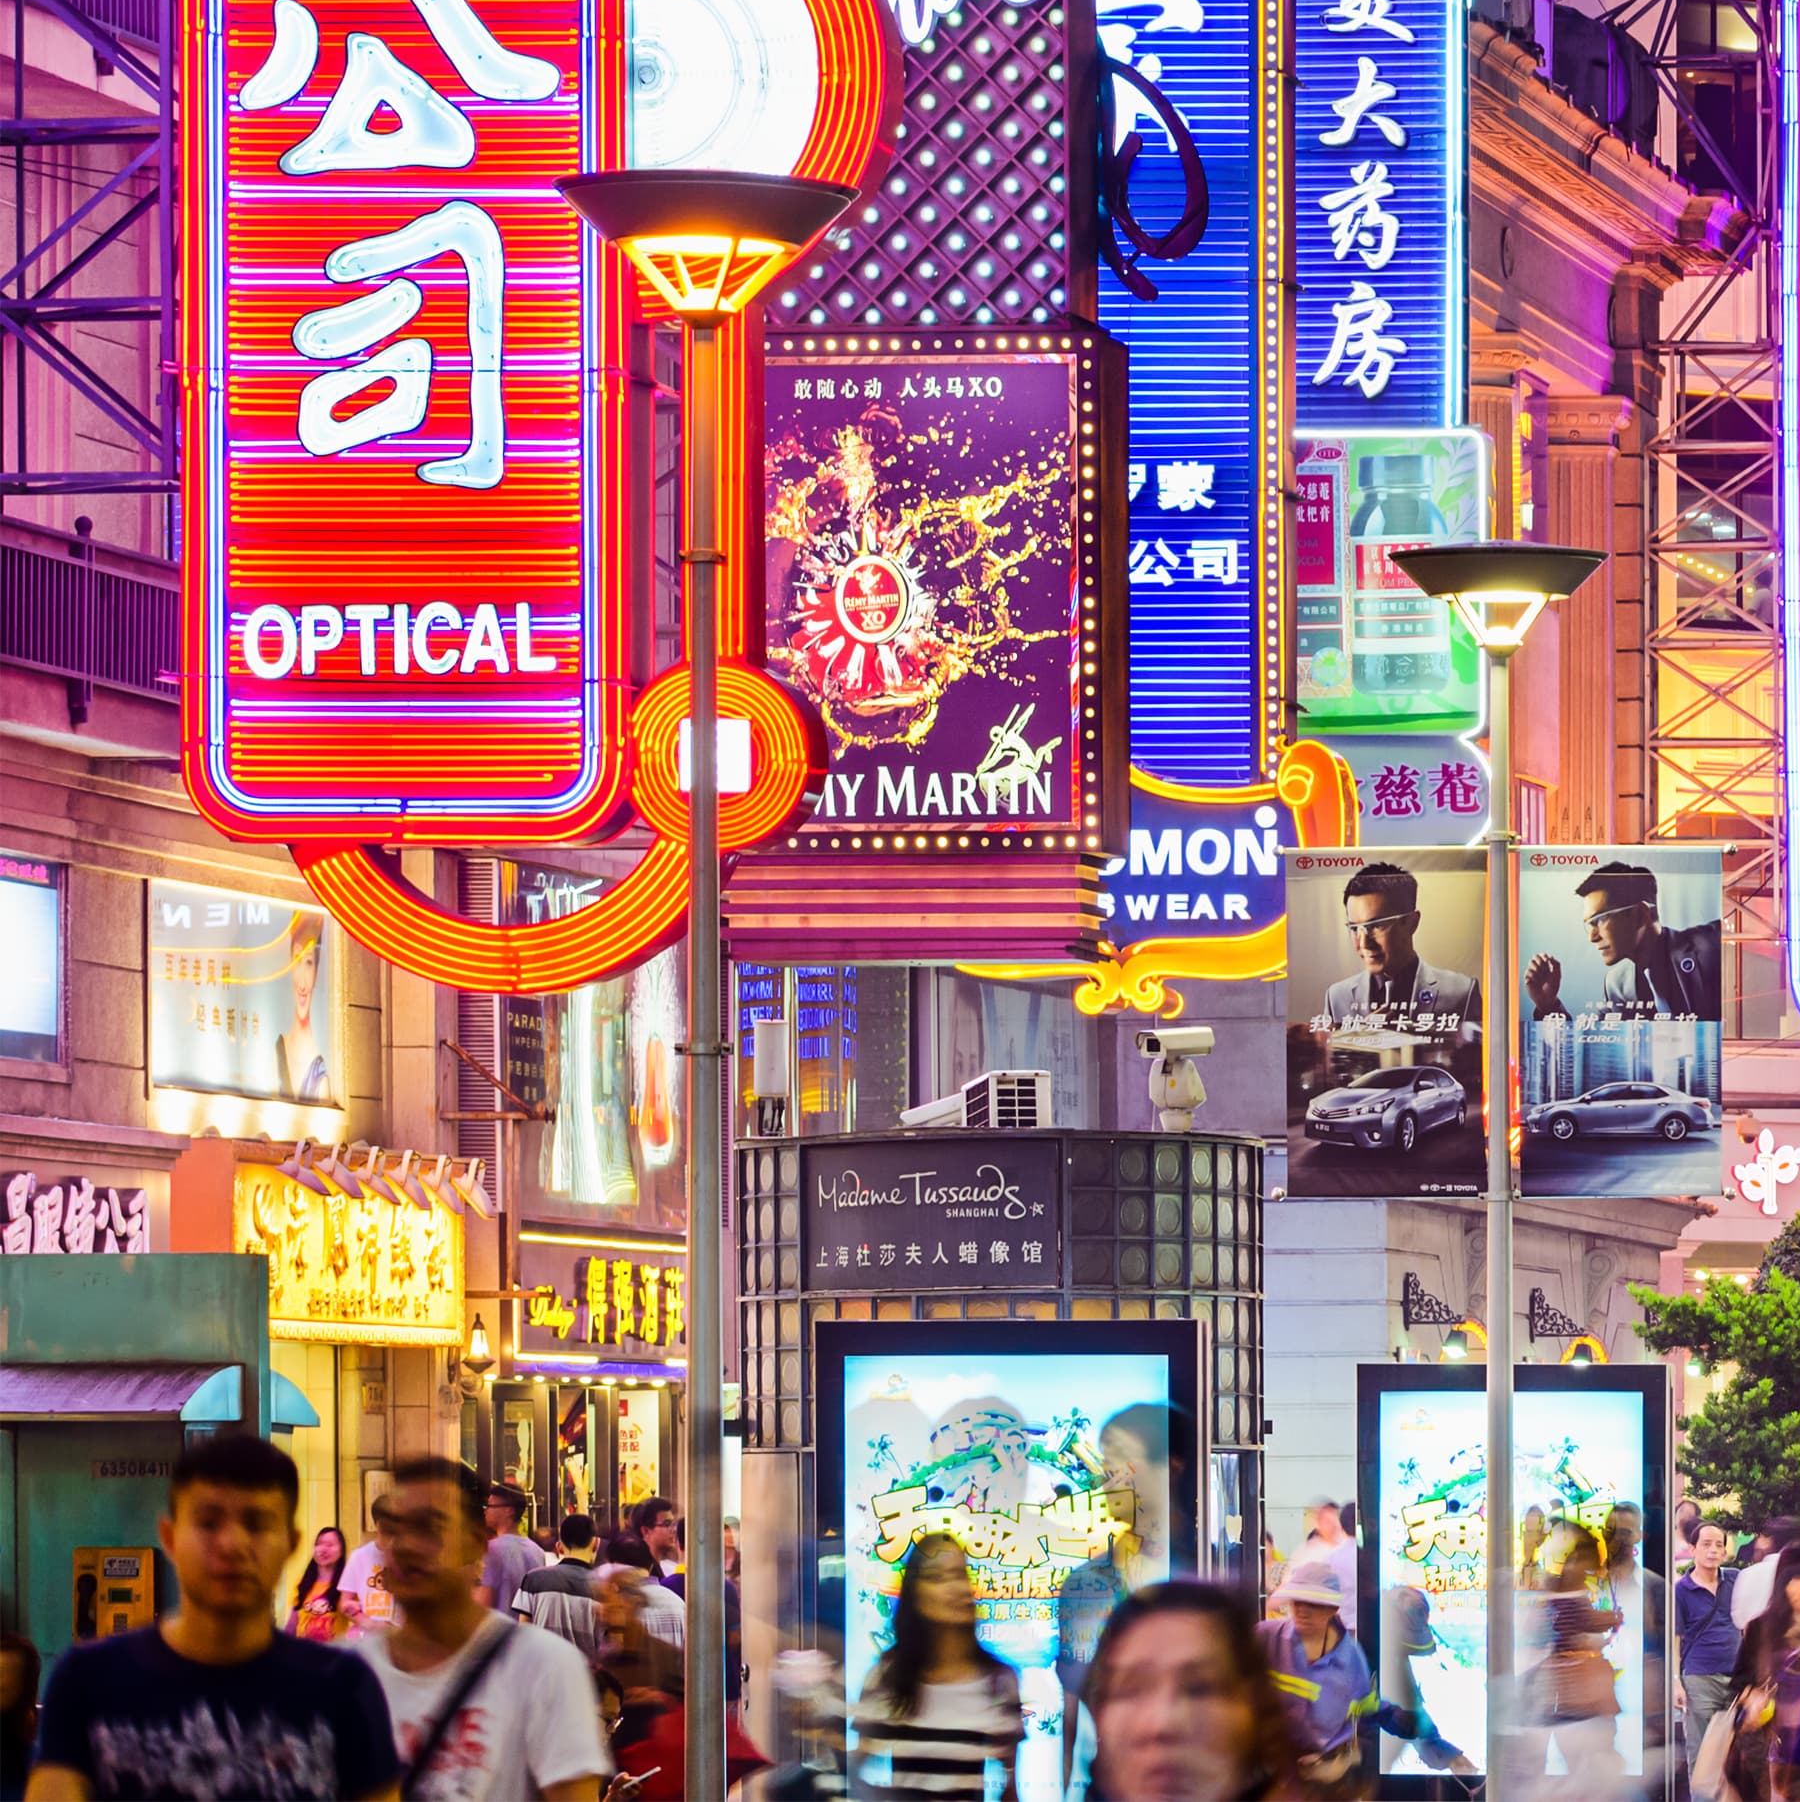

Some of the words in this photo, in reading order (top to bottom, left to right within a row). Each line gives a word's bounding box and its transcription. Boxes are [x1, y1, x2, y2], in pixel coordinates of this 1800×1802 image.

[794, 377, 882, 400] 敢随心动
[861, 611, 886, 626] XO
[242, 601, 557, 679] OPTICAL
[876, 765, 1052, 818] MARTIN
[1316, 855, 1365, 868] TOYOTA
[1550, 853, 1599, 865] TOYOTA
[1124, 893, 1252, 922] WEAR
[817, 1170, 906, 1210] Madame
[906, 1164, 1027, 1220] Tussauds
[945, 1208, 999, 1219] SHANGHAI
[817, 1240, 1043, 1268] 上海杜莎夫人蜡像馆
